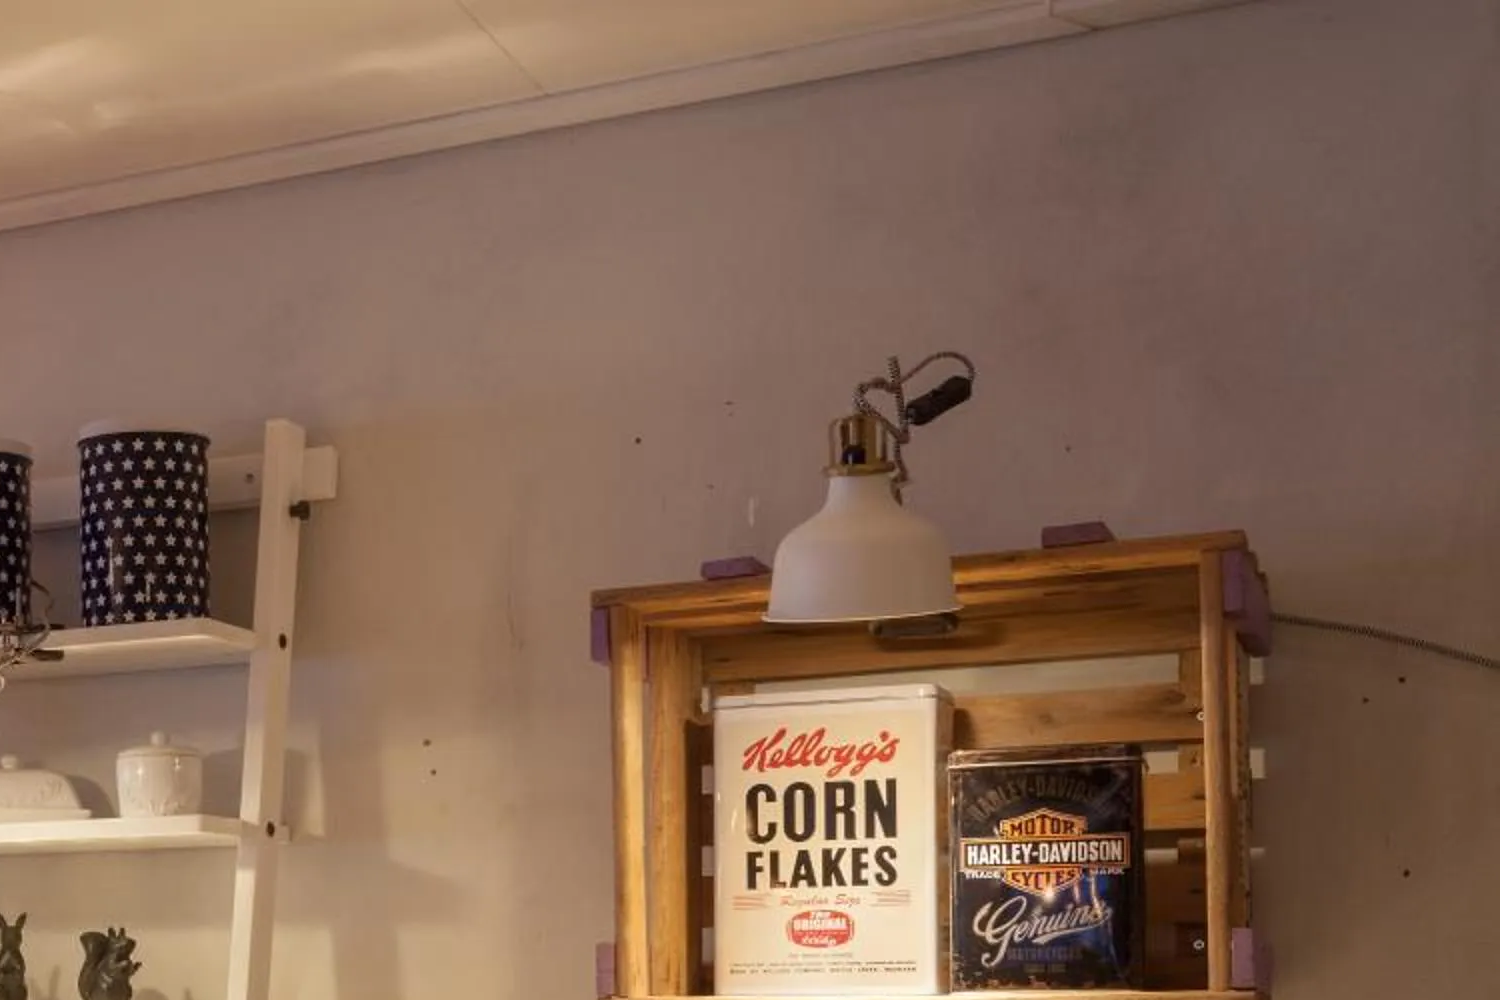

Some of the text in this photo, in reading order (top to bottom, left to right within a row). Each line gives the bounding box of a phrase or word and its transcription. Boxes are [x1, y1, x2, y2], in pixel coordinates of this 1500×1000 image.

[742, 727, 900, 777] Kellogg's
[745, 778, 898, 844] CORN
[966, 772, 1120, 823] HARLEY-DAVIDS
[1010, 813, 1076, 836] MOTOR
[746, 845, 898, 890] FLAKES
[967, 839, 1124, 866] HARLEY-DAVIDSON
[1011, 868, 1076, 892] CYCLES
[972, 895, 1114, 967] Genuine
